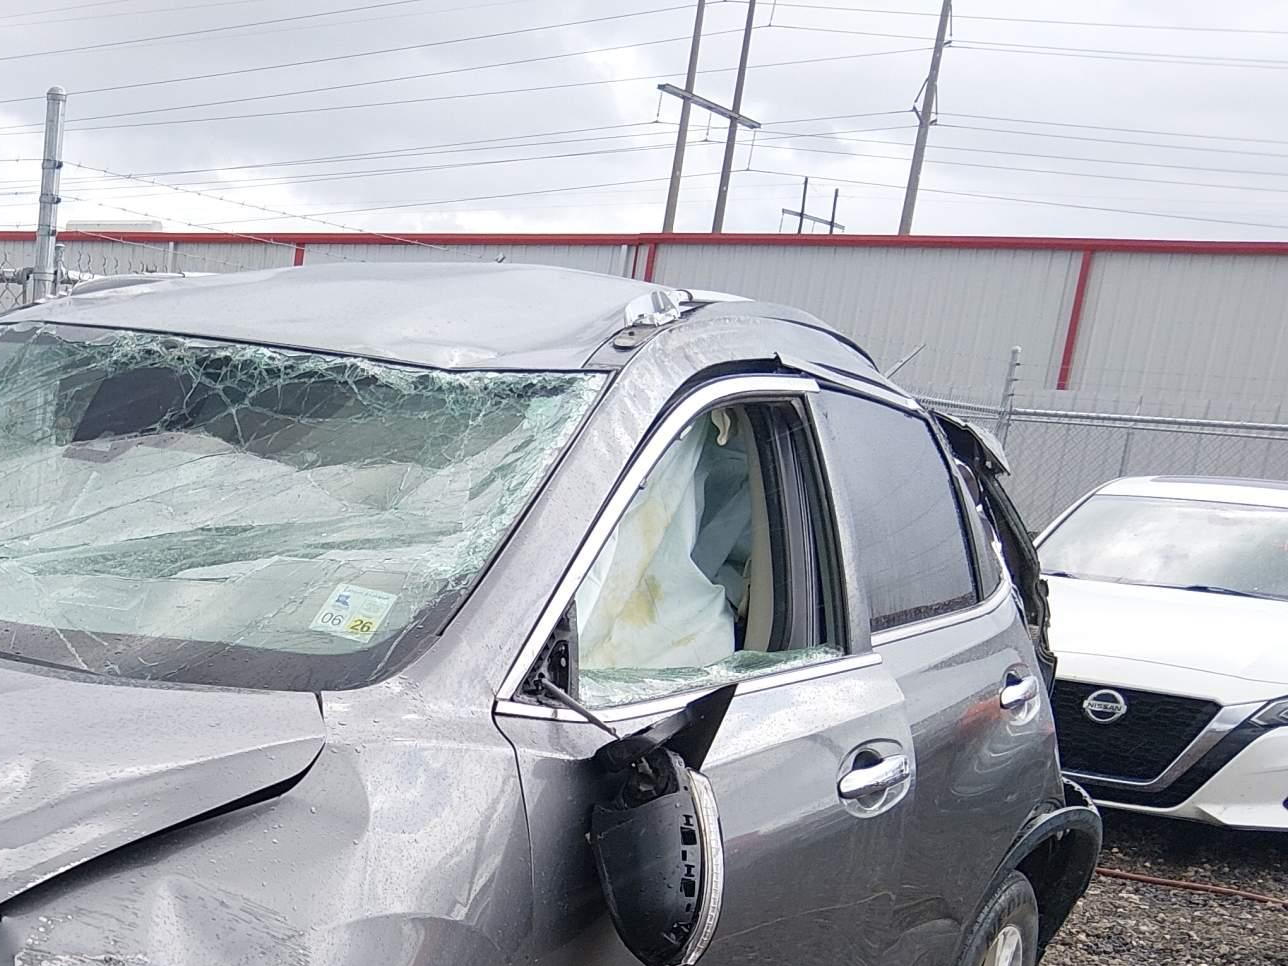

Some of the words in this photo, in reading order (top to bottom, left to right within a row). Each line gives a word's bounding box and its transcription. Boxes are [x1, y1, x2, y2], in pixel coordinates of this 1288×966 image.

[321, 612, 344, 626] 06
[350, 619, 373, 633] 26
[1087, 701, 1123, 712] NISSAN
